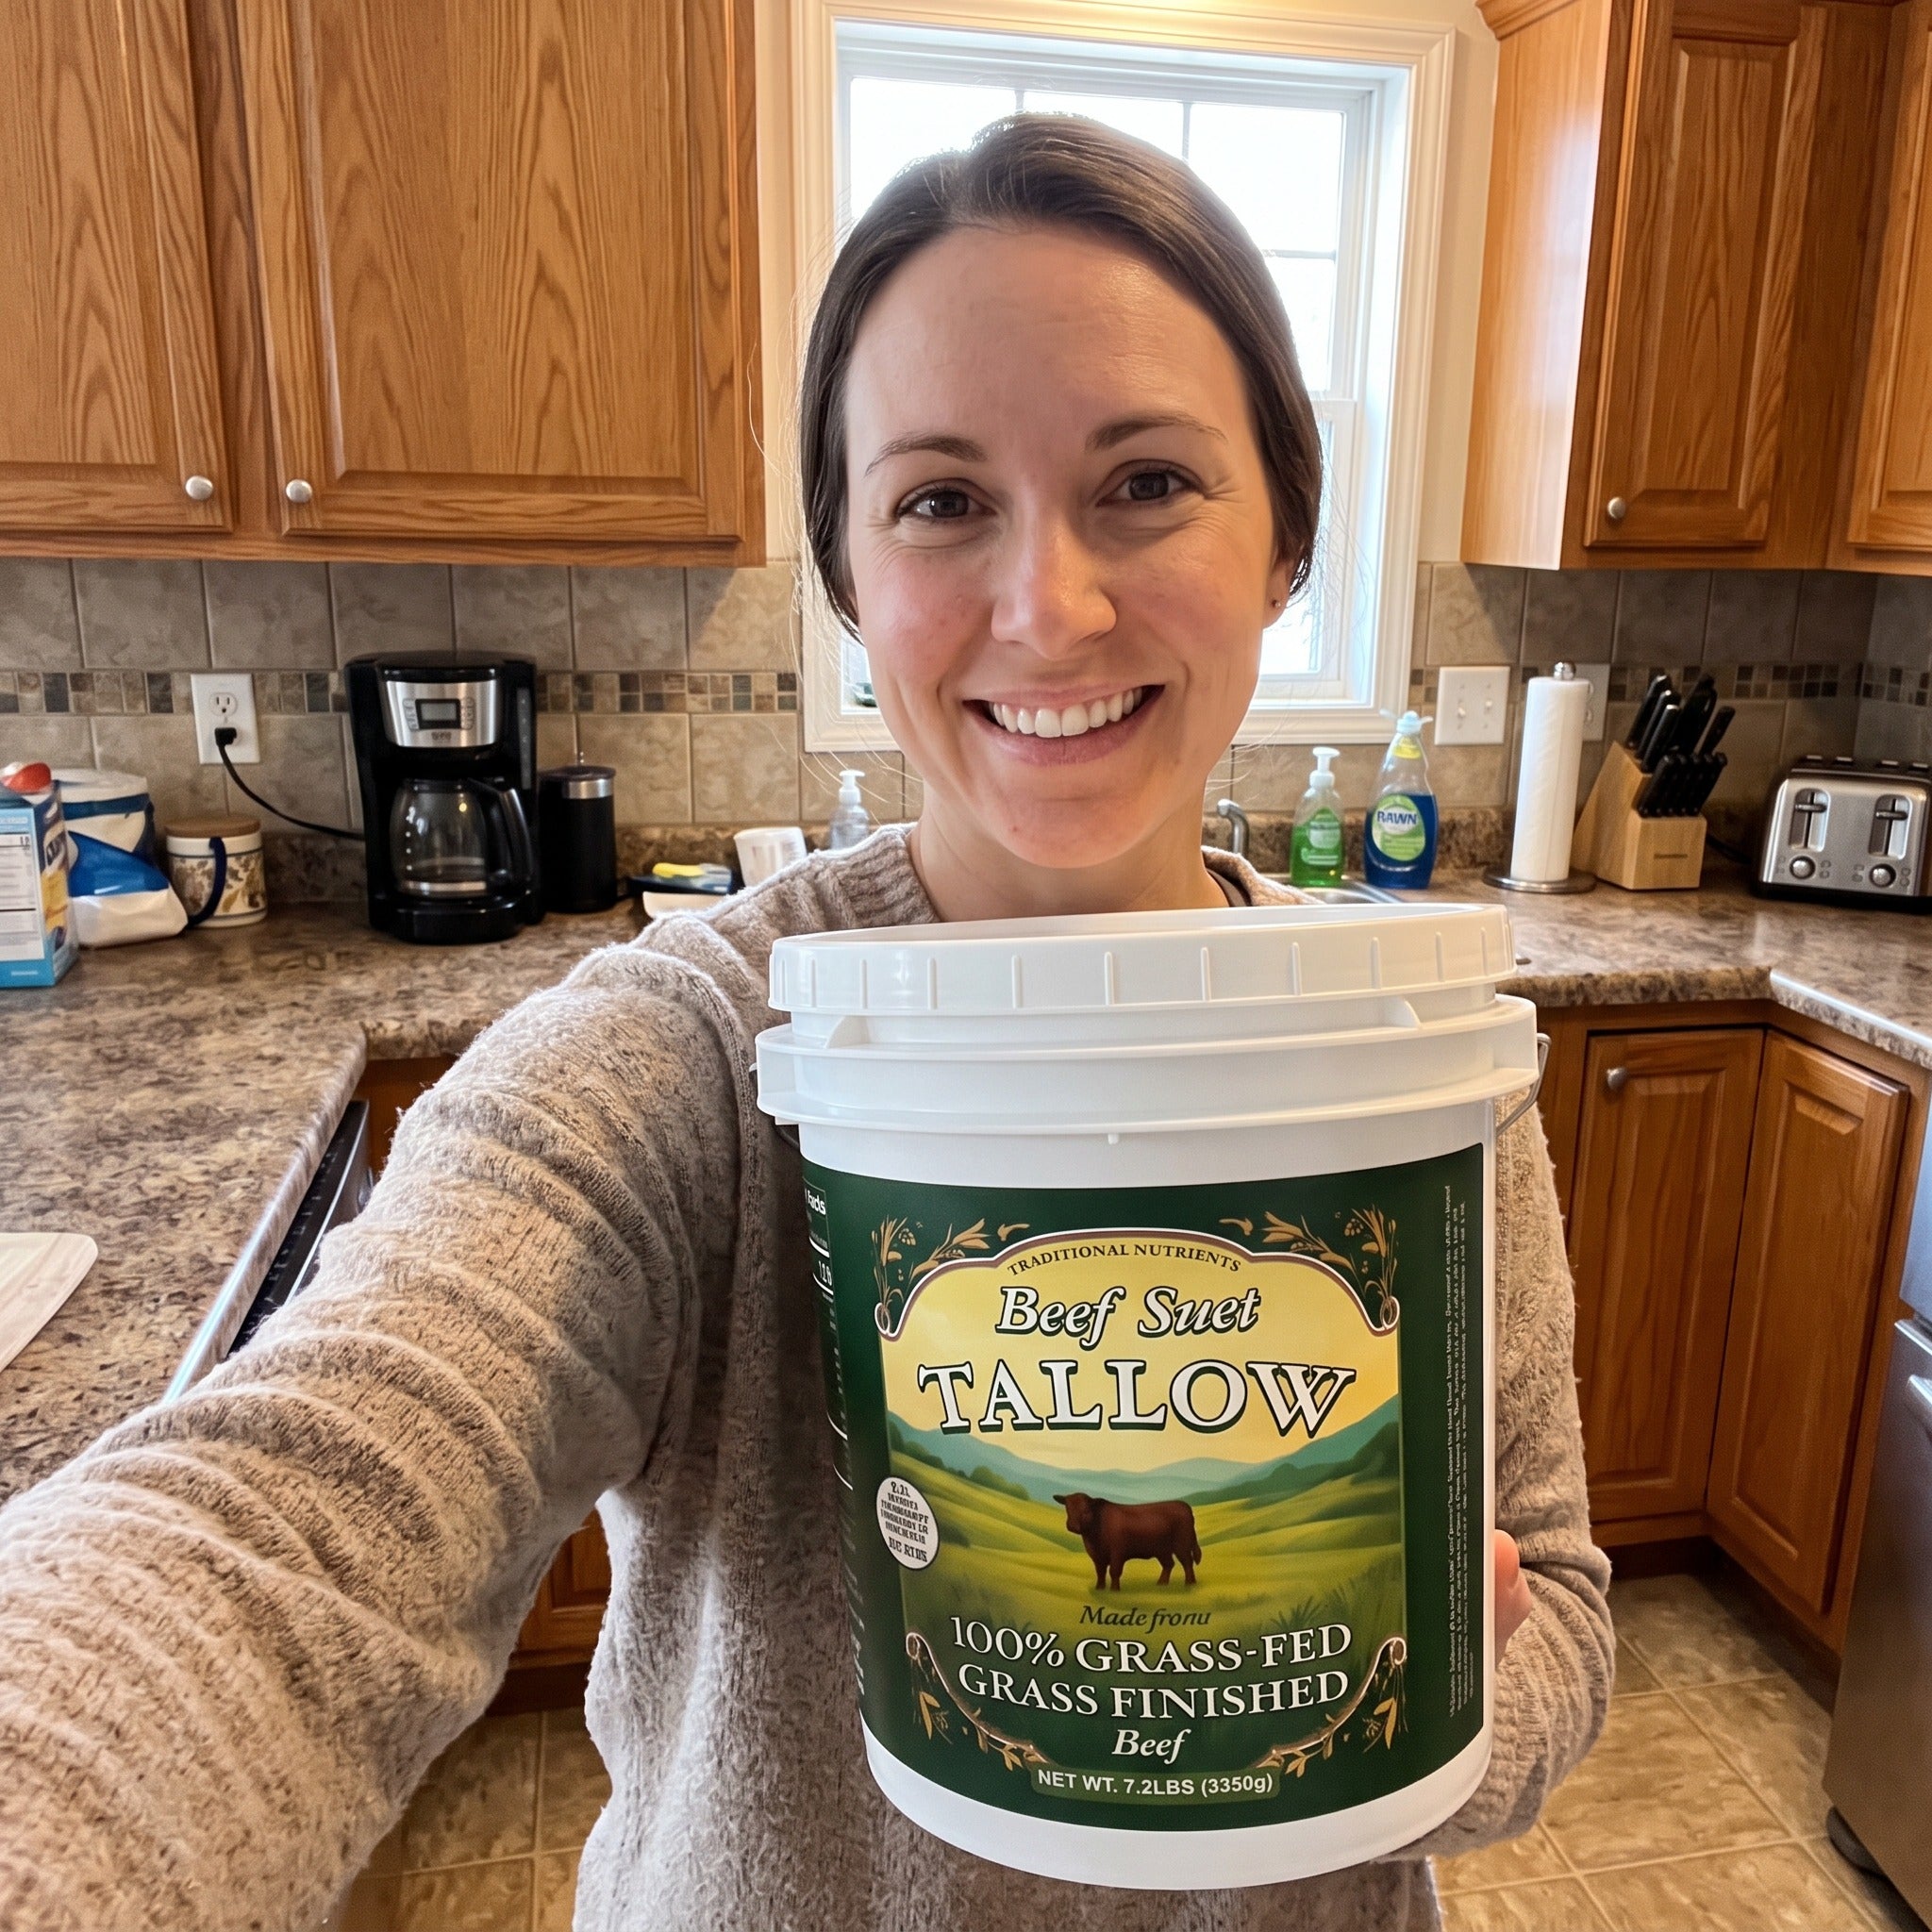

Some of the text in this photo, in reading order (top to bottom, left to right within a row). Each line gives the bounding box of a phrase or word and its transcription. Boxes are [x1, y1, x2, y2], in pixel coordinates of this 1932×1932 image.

[1008, 1244, 1241, 1275] TRADITIONAL NUTRIENTS
[995, 1286, 1261, 1351] Beef Suet
[917, 1358, 1357, 1439] TALLOW
[1079, 1606, 1147, 1626] Made
[950, 1617, 1352, 1674] 100% GRASS-FED
[958, 1663, 1349, 1719] GRASS FINISHED
[1111, 1729, 1191, 1765] Beef
[1038, 1770, 1273, 1797] NET WT. 7.2LBS (3350g)
